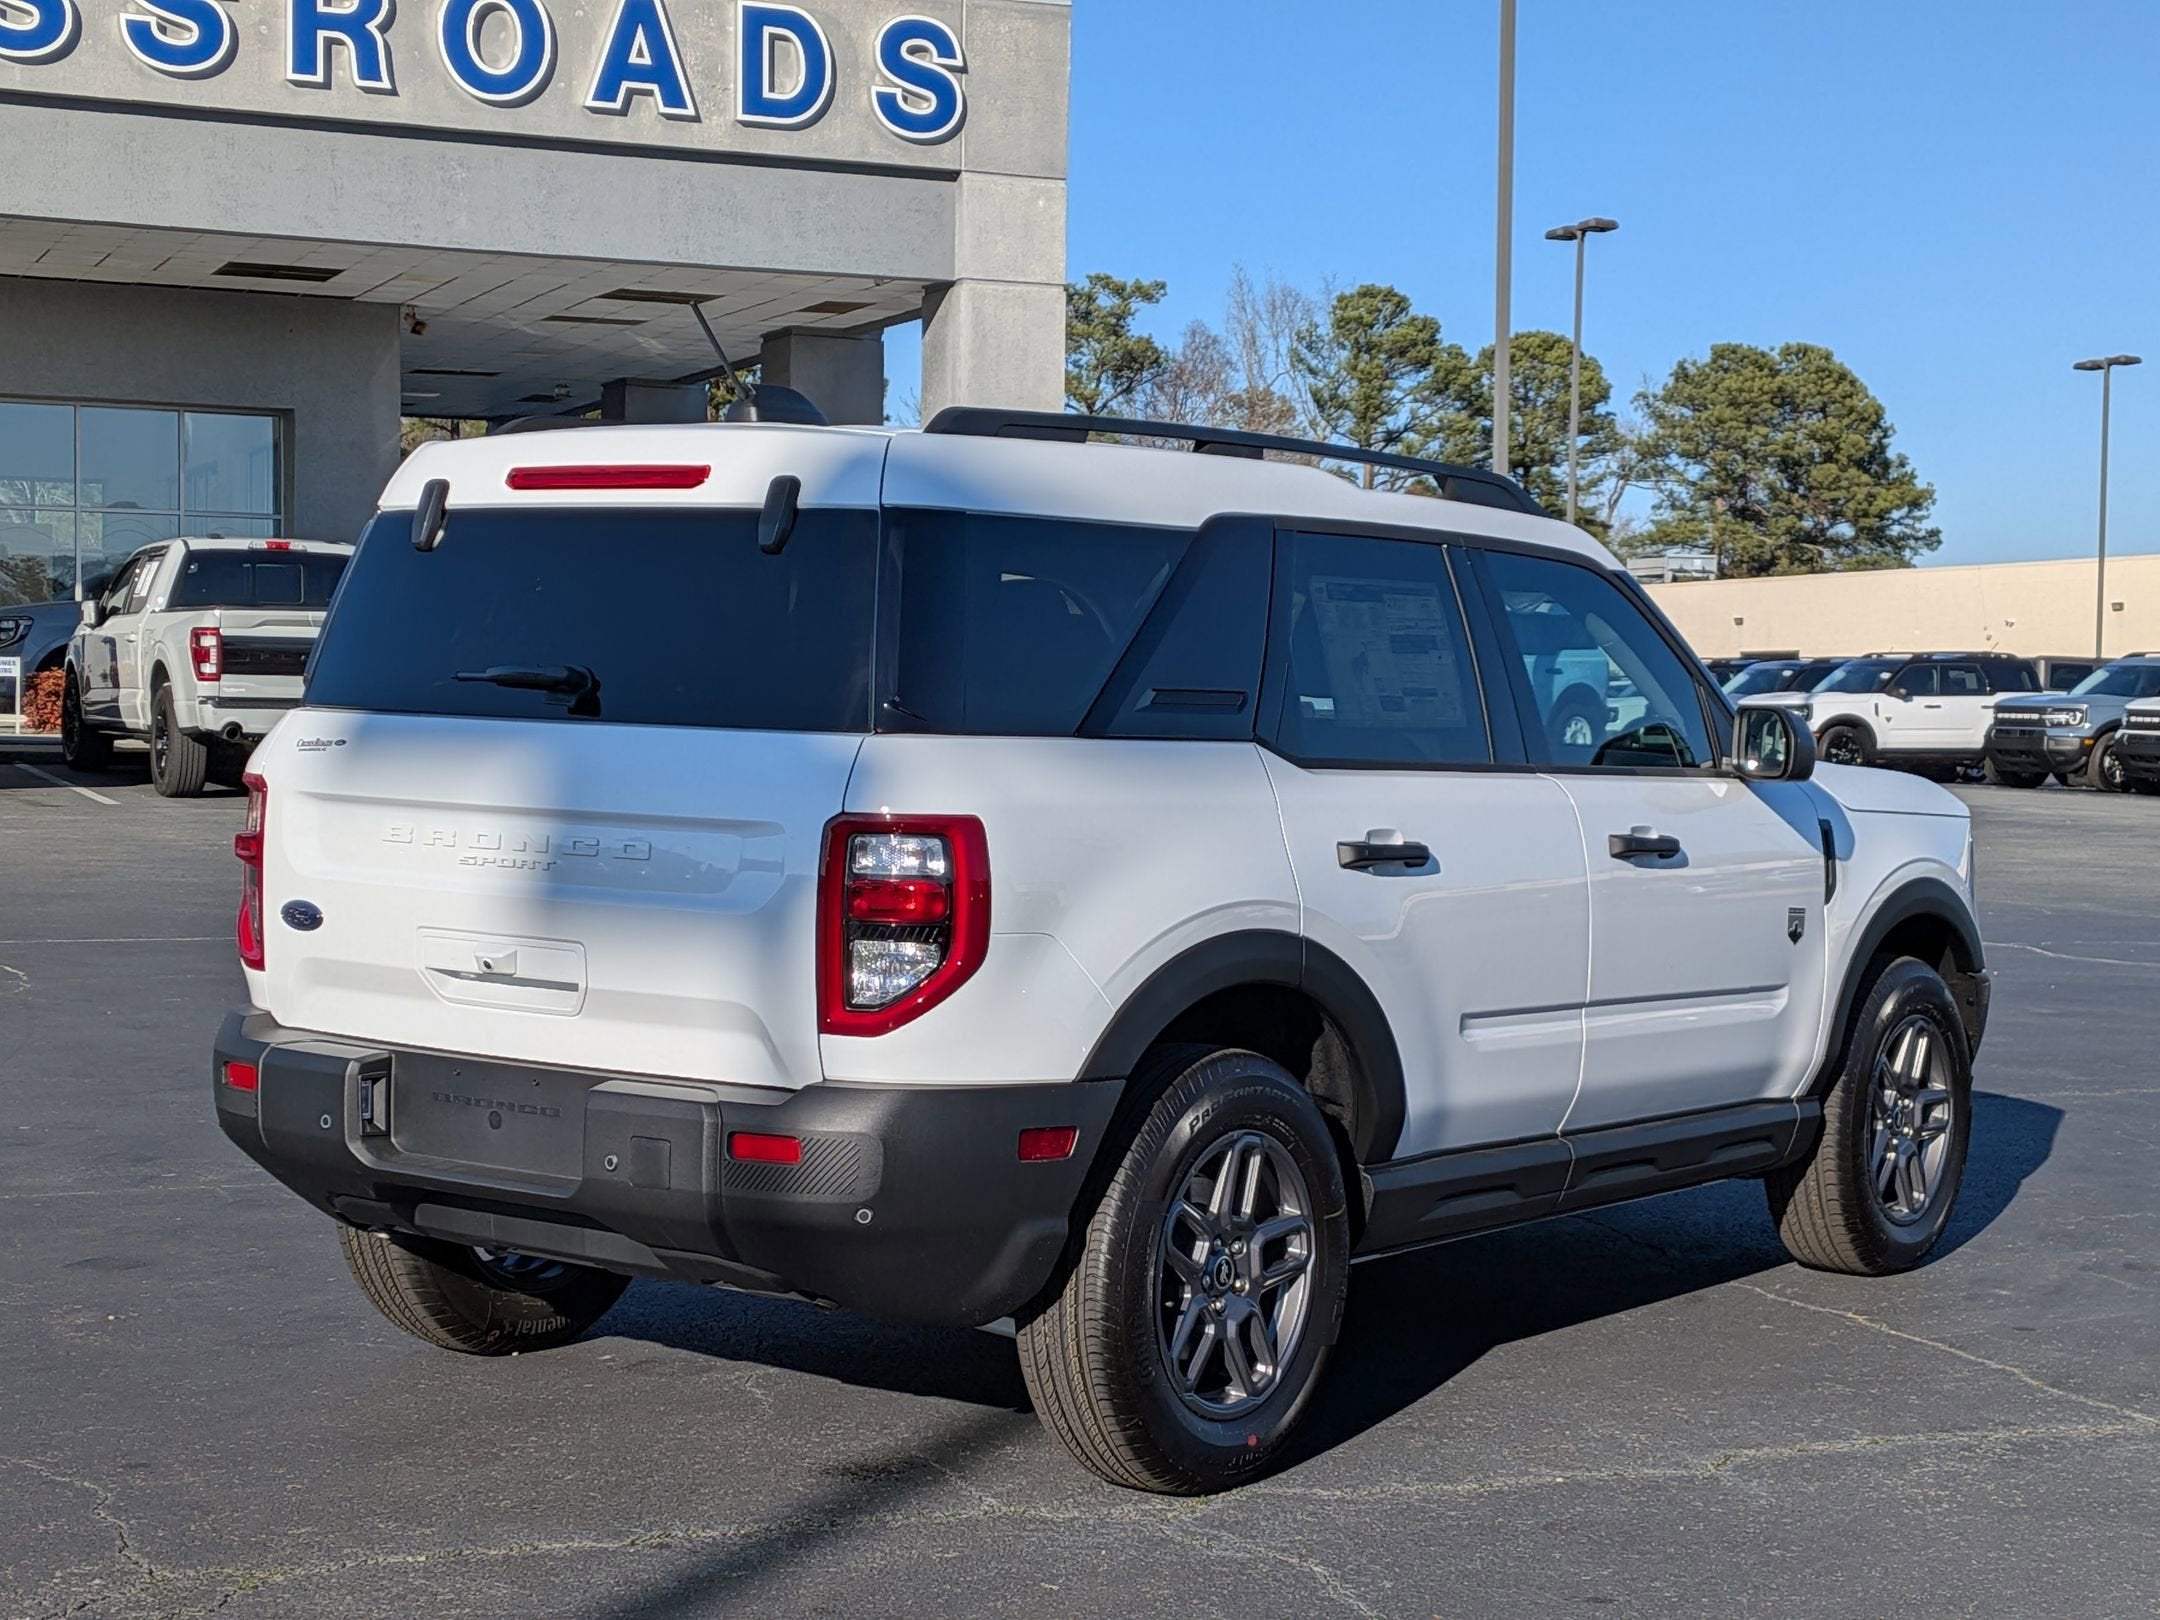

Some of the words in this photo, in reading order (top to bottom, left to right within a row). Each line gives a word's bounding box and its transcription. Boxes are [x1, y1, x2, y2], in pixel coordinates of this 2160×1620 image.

[382, 825, 653, 861] BRONCO
[458, 855, 558, 871] SPORT
[432, 1090, 561, 1118] BRONCO
